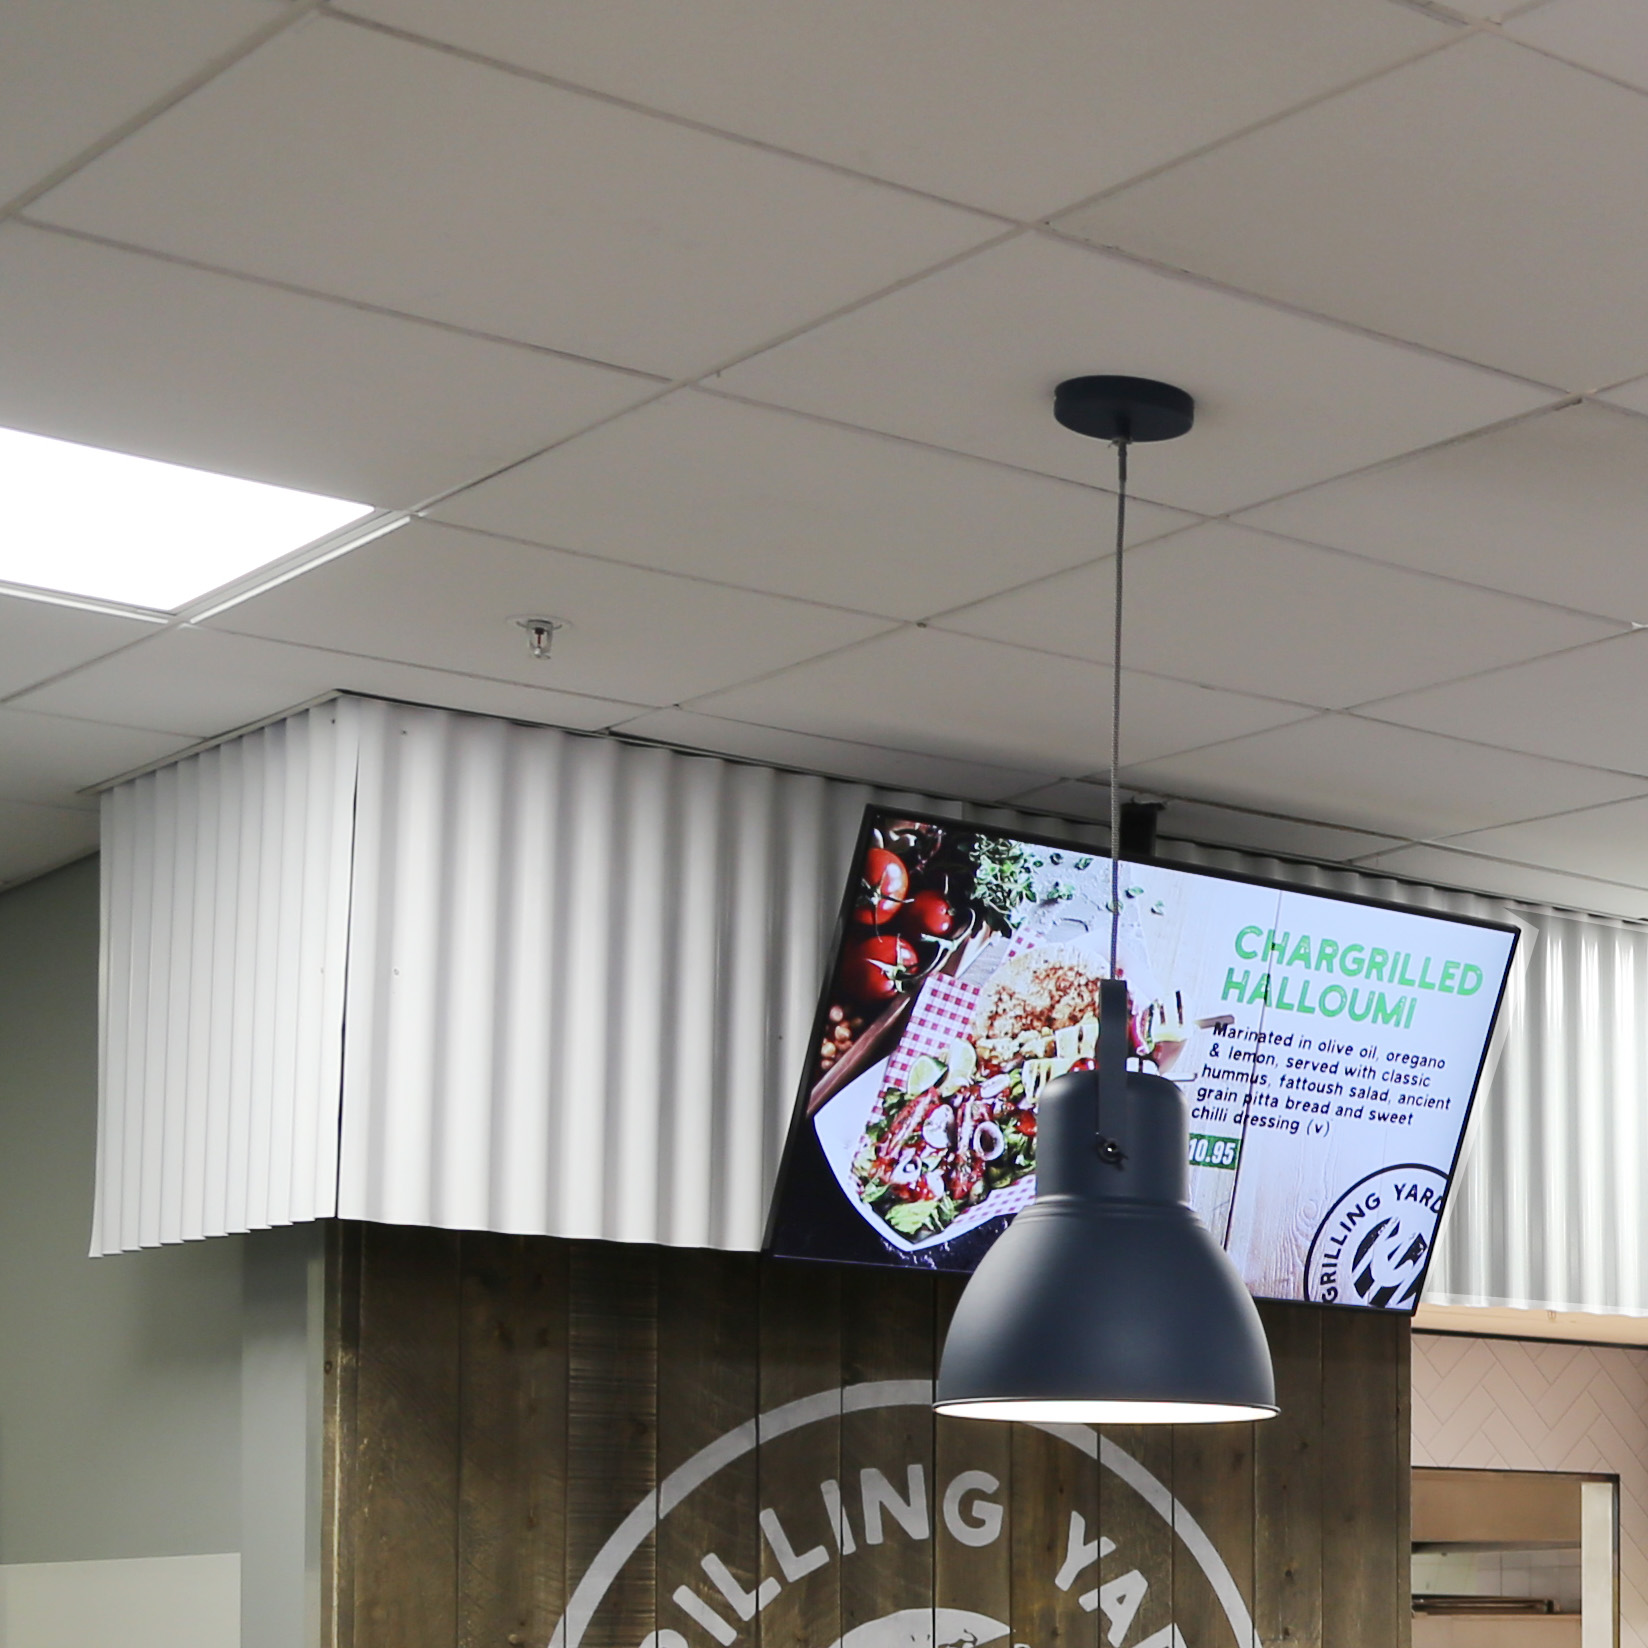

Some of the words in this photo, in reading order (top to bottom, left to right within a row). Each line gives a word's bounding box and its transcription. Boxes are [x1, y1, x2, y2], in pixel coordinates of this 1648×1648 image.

[1234, 925, 1483, 996] CHARGRILLED
[1221, 967, 1417, 1029] HALLOUMI
[1209, 1044, 1220, 1058] &
[1229, 1046, 1278, 1068] lemon,
[1286, 1055, 1338, 1075] served
[1344, 1064, 1377, 1080] with
[1382, 1070, 1431, 1088] classic
[1212, 1022, 1293, 1048] Marinated
[1299, 1035, 1312, 1050] in
[1318, 1040, 1353, 1056] olive
[1360, 1044, 1379, 1061] oil,
[1386, 1051, 1446, 1070] oregano
[1197, 1086, 1237, 1103] grain
[1243, 1092, 1279, 1108] pitta
[1285, 1095, 1329, 1115] bread
[1335, 1103, 1363, 1120] and
[1369, 1109, 1414, 1125] sweet
[1201, 1064, 1271, 1088] hummus,
[1279, 1074, 1343, 1096] fattoush
[1349, 1084, 1391, 1103] salad,
[1398, 1093, 1451, 1111] ancient
[1191, 1105, 1227, 1123] chilli
[1233, 1111, 1300, 1134] dressing
[1306, 1118, 1331, 1138] (v)
[1320, 1192, 1381, 1303] GRILLING
